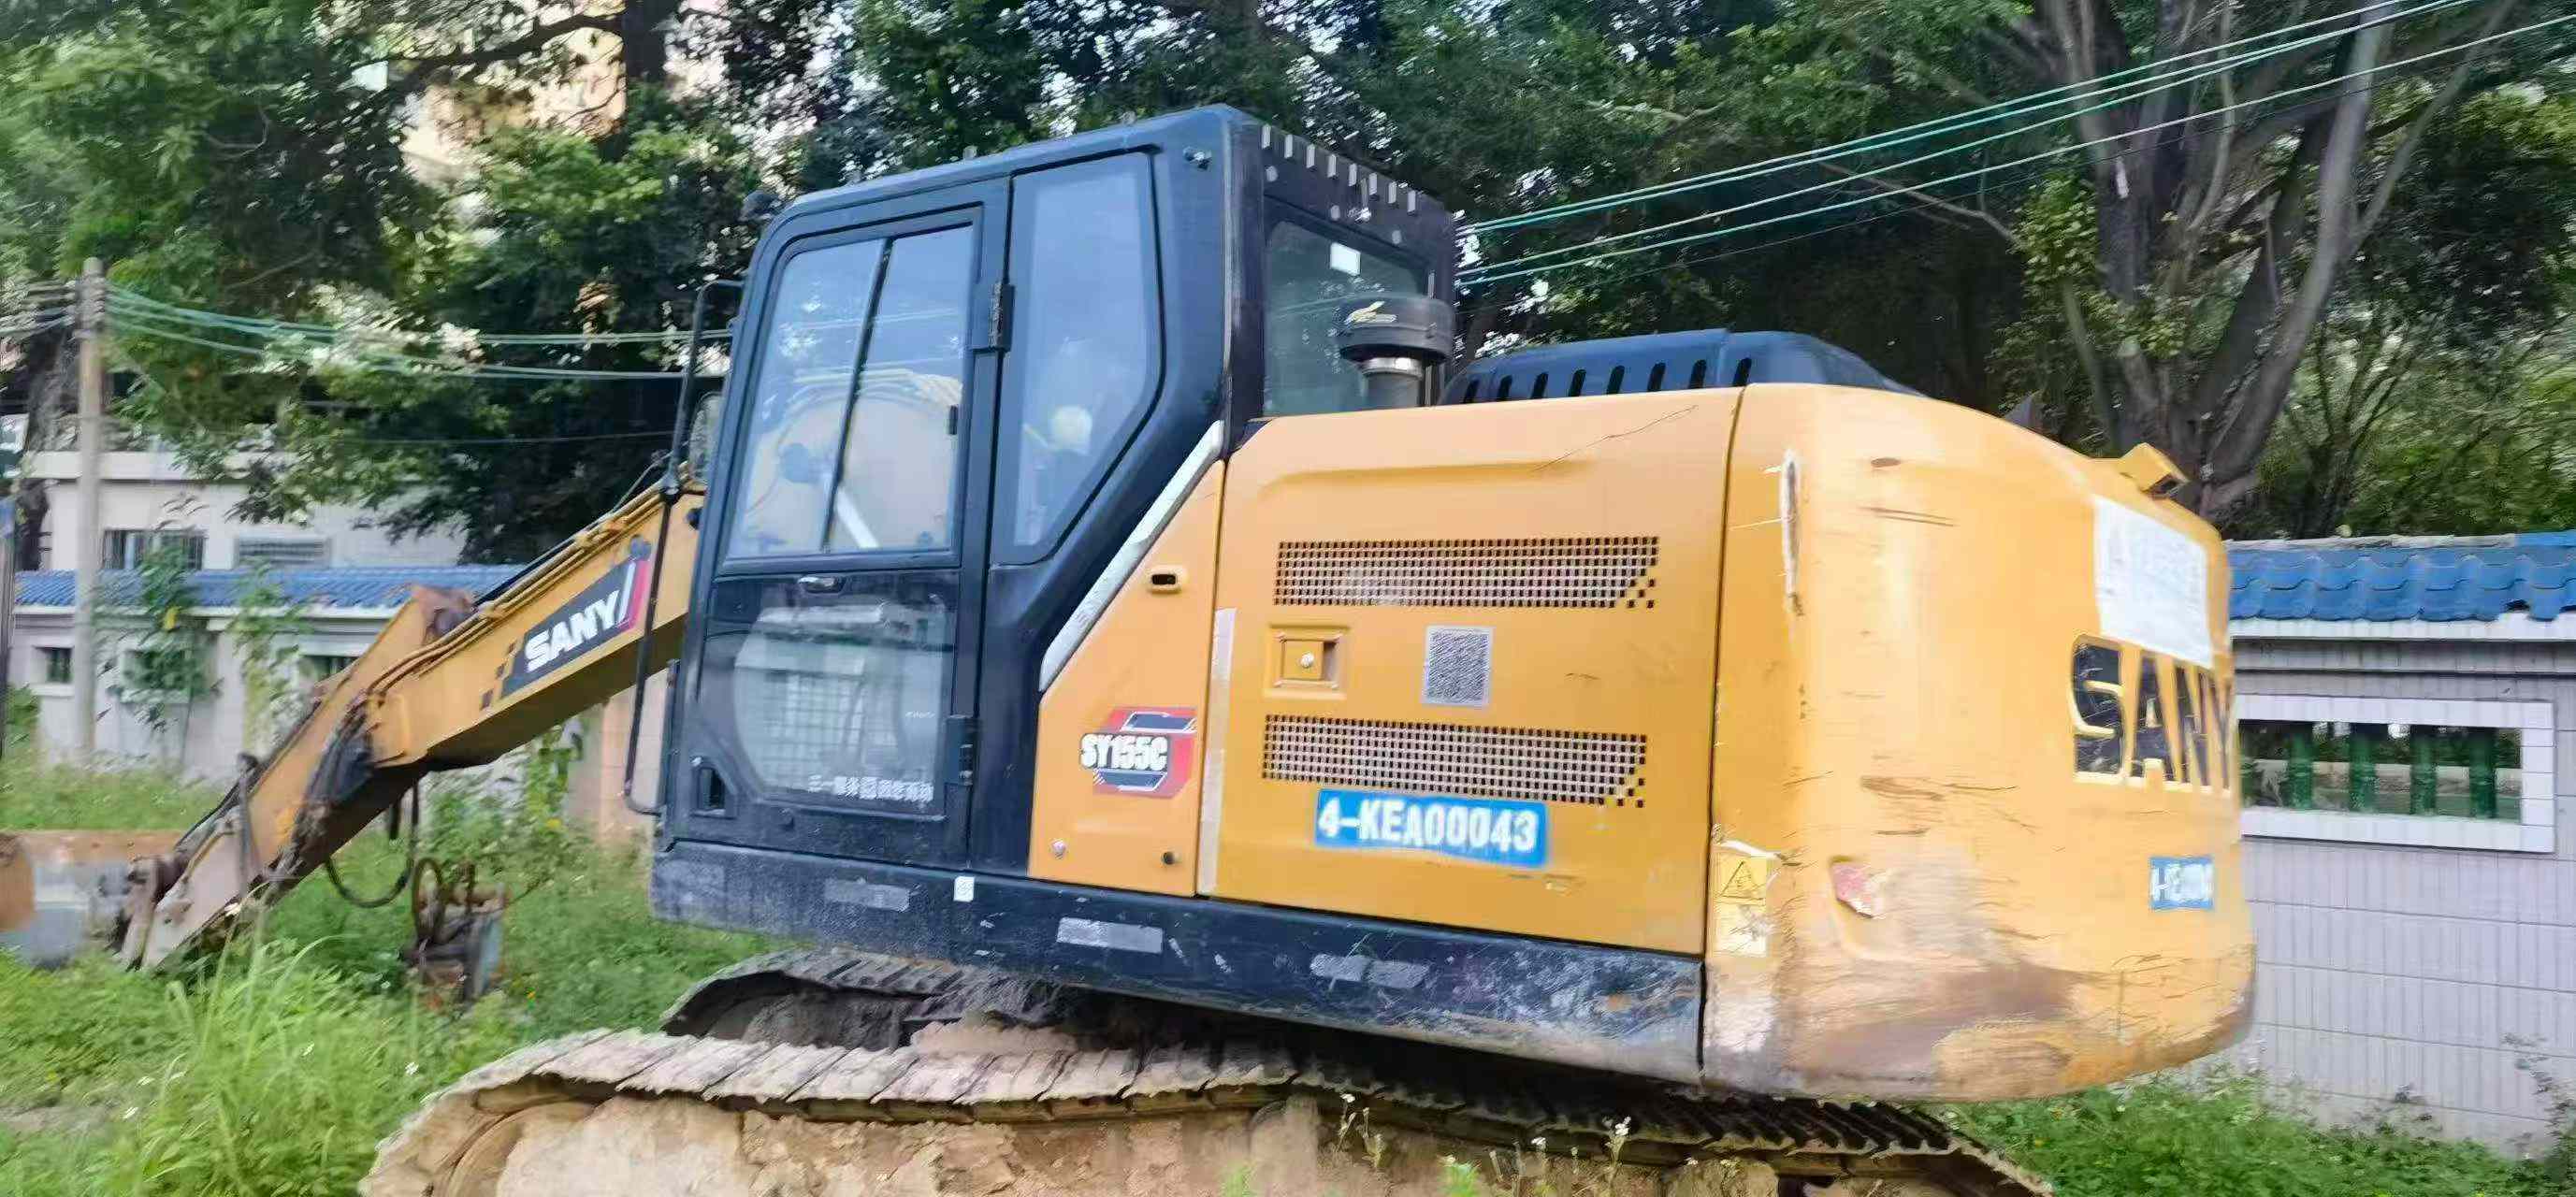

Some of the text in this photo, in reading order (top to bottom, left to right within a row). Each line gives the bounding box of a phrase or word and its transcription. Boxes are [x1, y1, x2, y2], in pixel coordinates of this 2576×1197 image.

[525, 589, 620, 672] SANY
[1079, 733, 1168, 772] SY155C
[1317, 797, 1539, 852] 4-KEA00043
